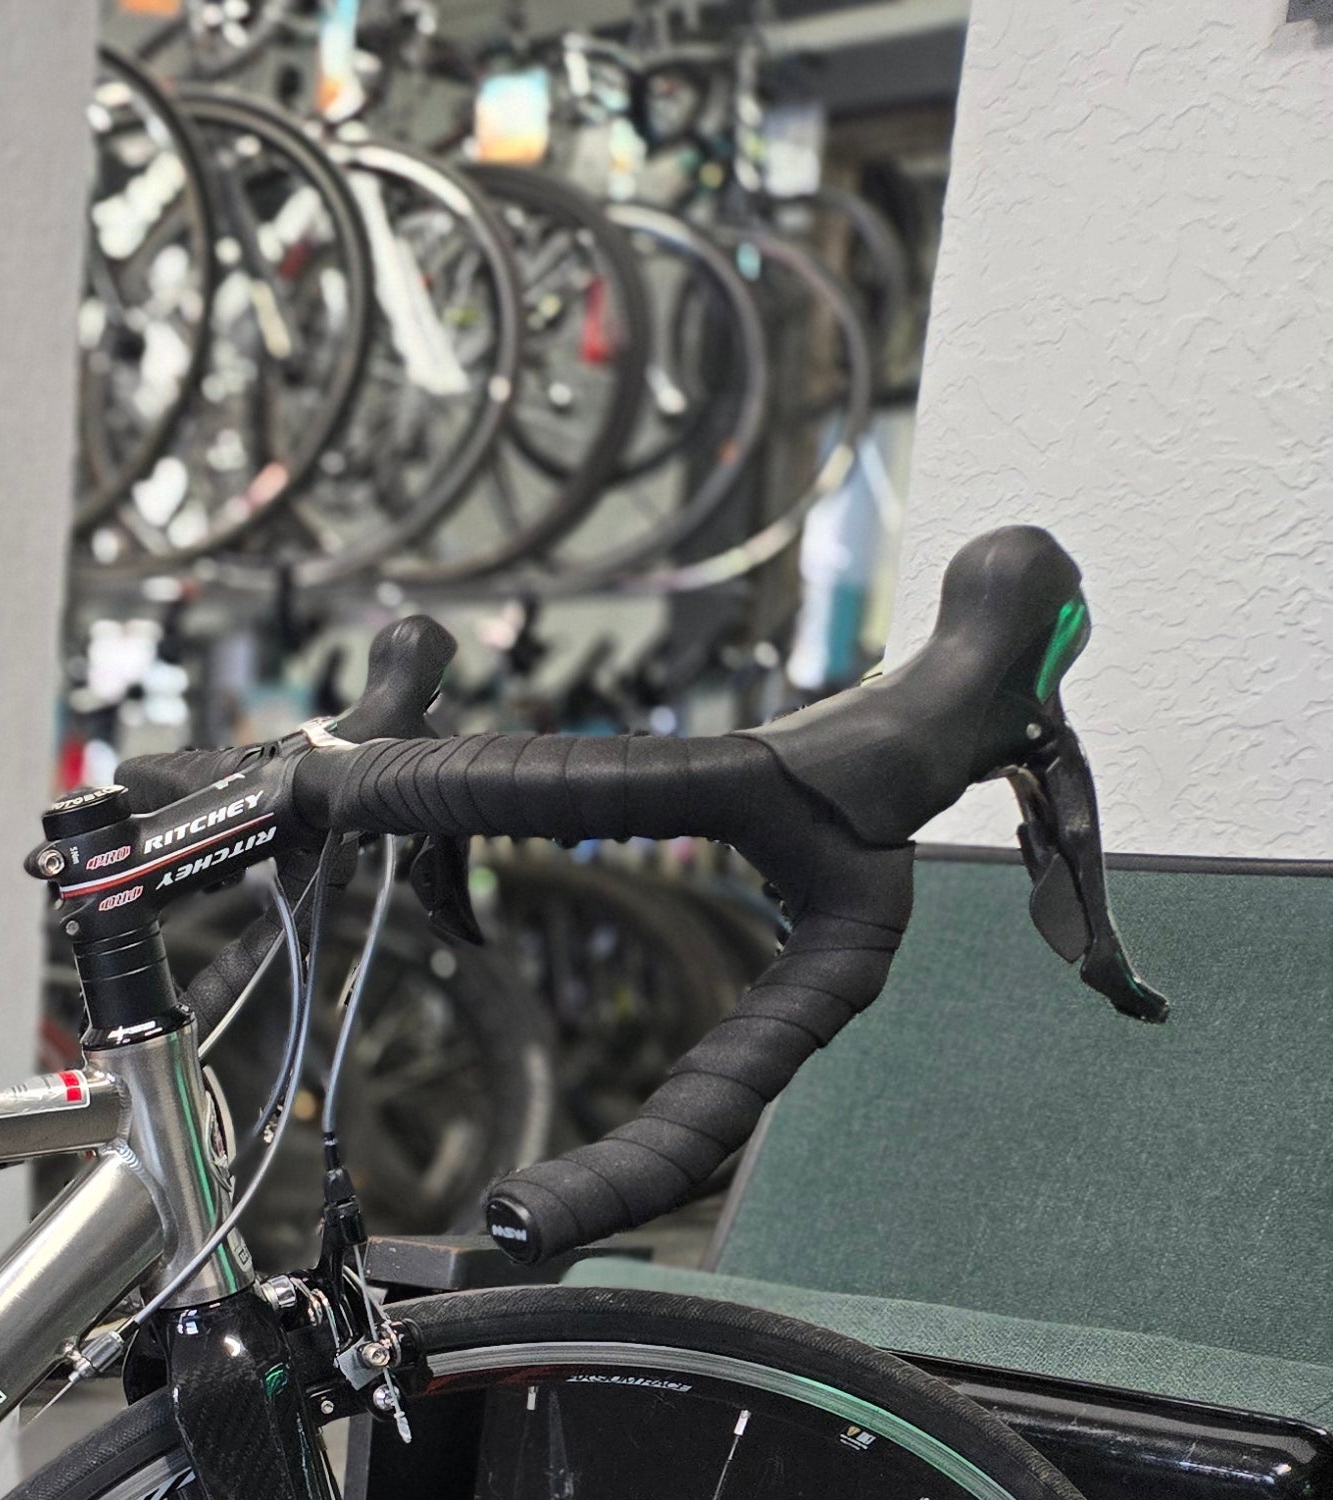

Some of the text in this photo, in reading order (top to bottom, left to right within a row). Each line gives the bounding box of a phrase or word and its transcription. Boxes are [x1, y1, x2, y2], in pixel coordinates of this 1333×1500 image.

[143, 790, 264, 854] RITCHEY
[155, 826, 277, 890] RITCHEY
[492, 1225, 527, 1241] MSW
